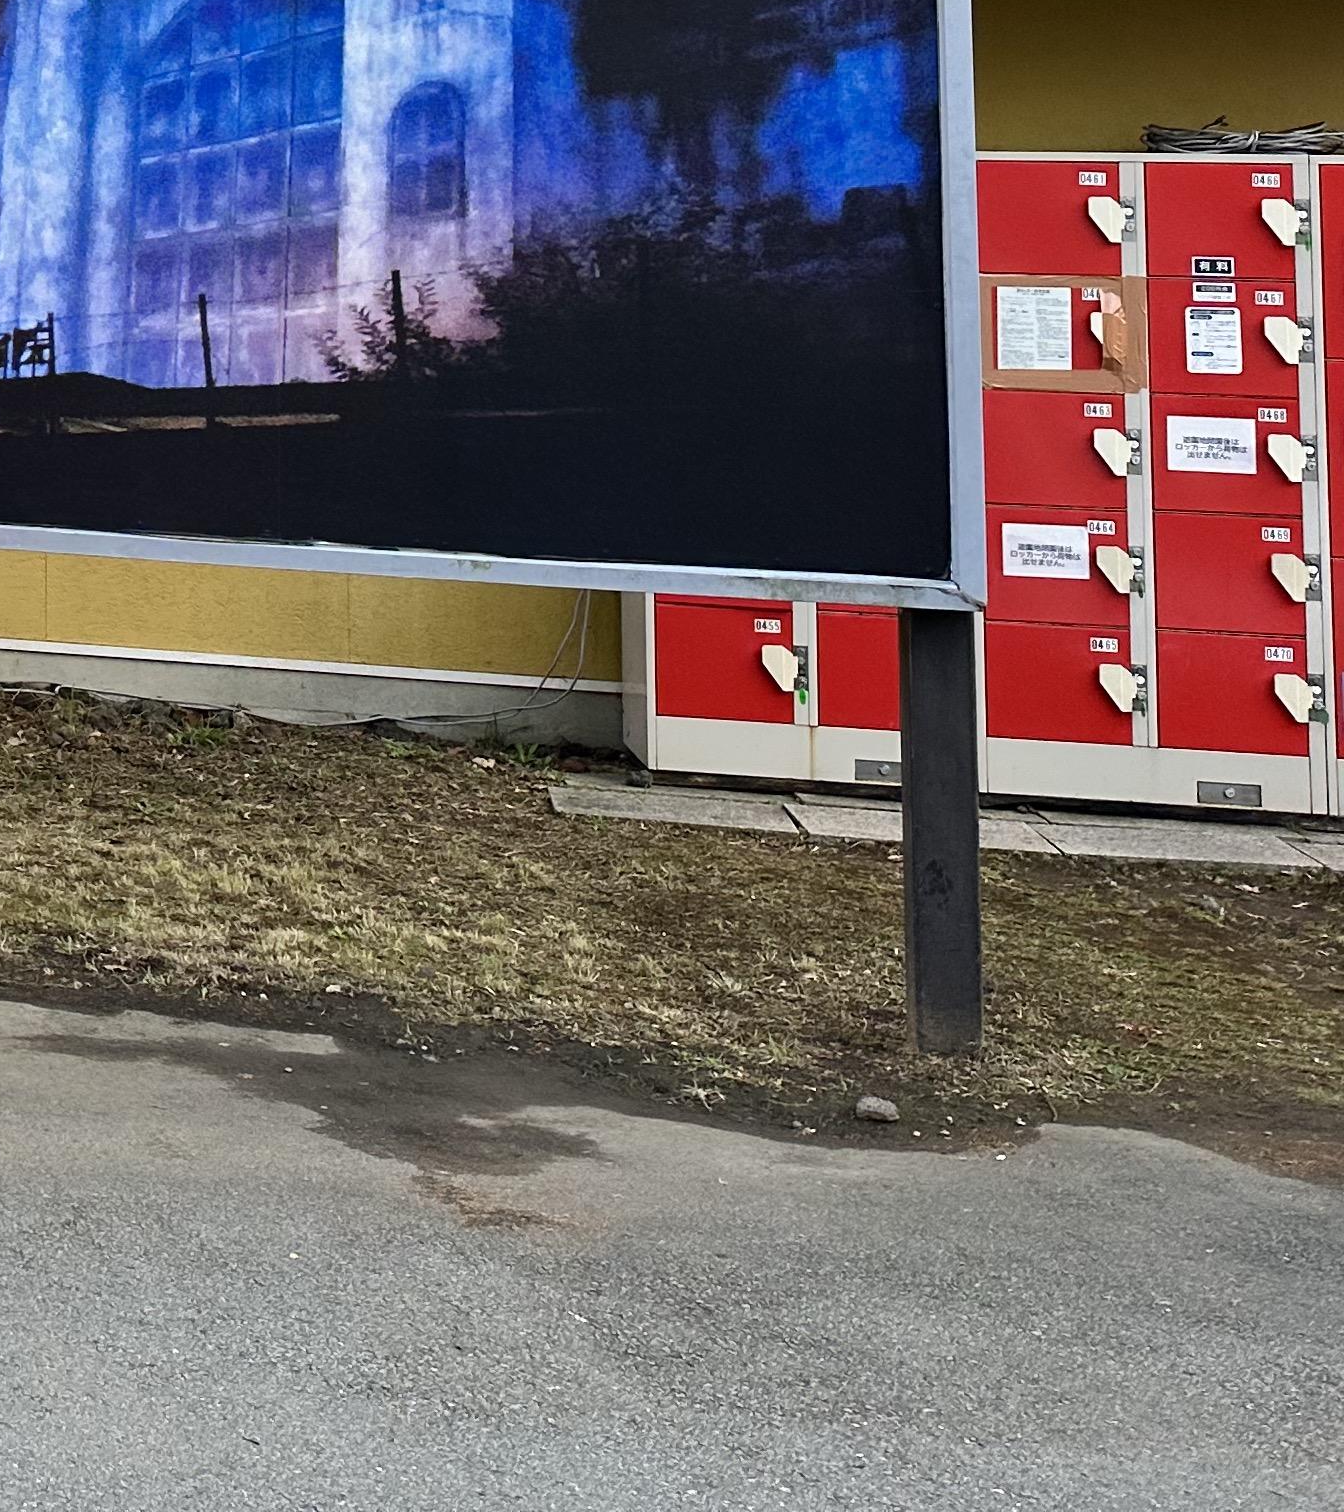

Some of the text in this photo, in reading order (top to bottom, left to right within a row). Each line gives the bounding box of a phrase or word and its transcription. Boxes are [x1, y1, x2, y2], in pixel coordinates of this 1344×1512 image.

[1080, 173, 1104, 185] 0461
[1253, 175, 1279, 186] 0466
[1256, 292, 1282, 304] 0467
[1259, 409, 1285, 420] 0468
[1089, 522, 1113, 533] 0464
[1091, 639, 1117, 651] 0465
[1266, 648, 1293, 660] 0470
